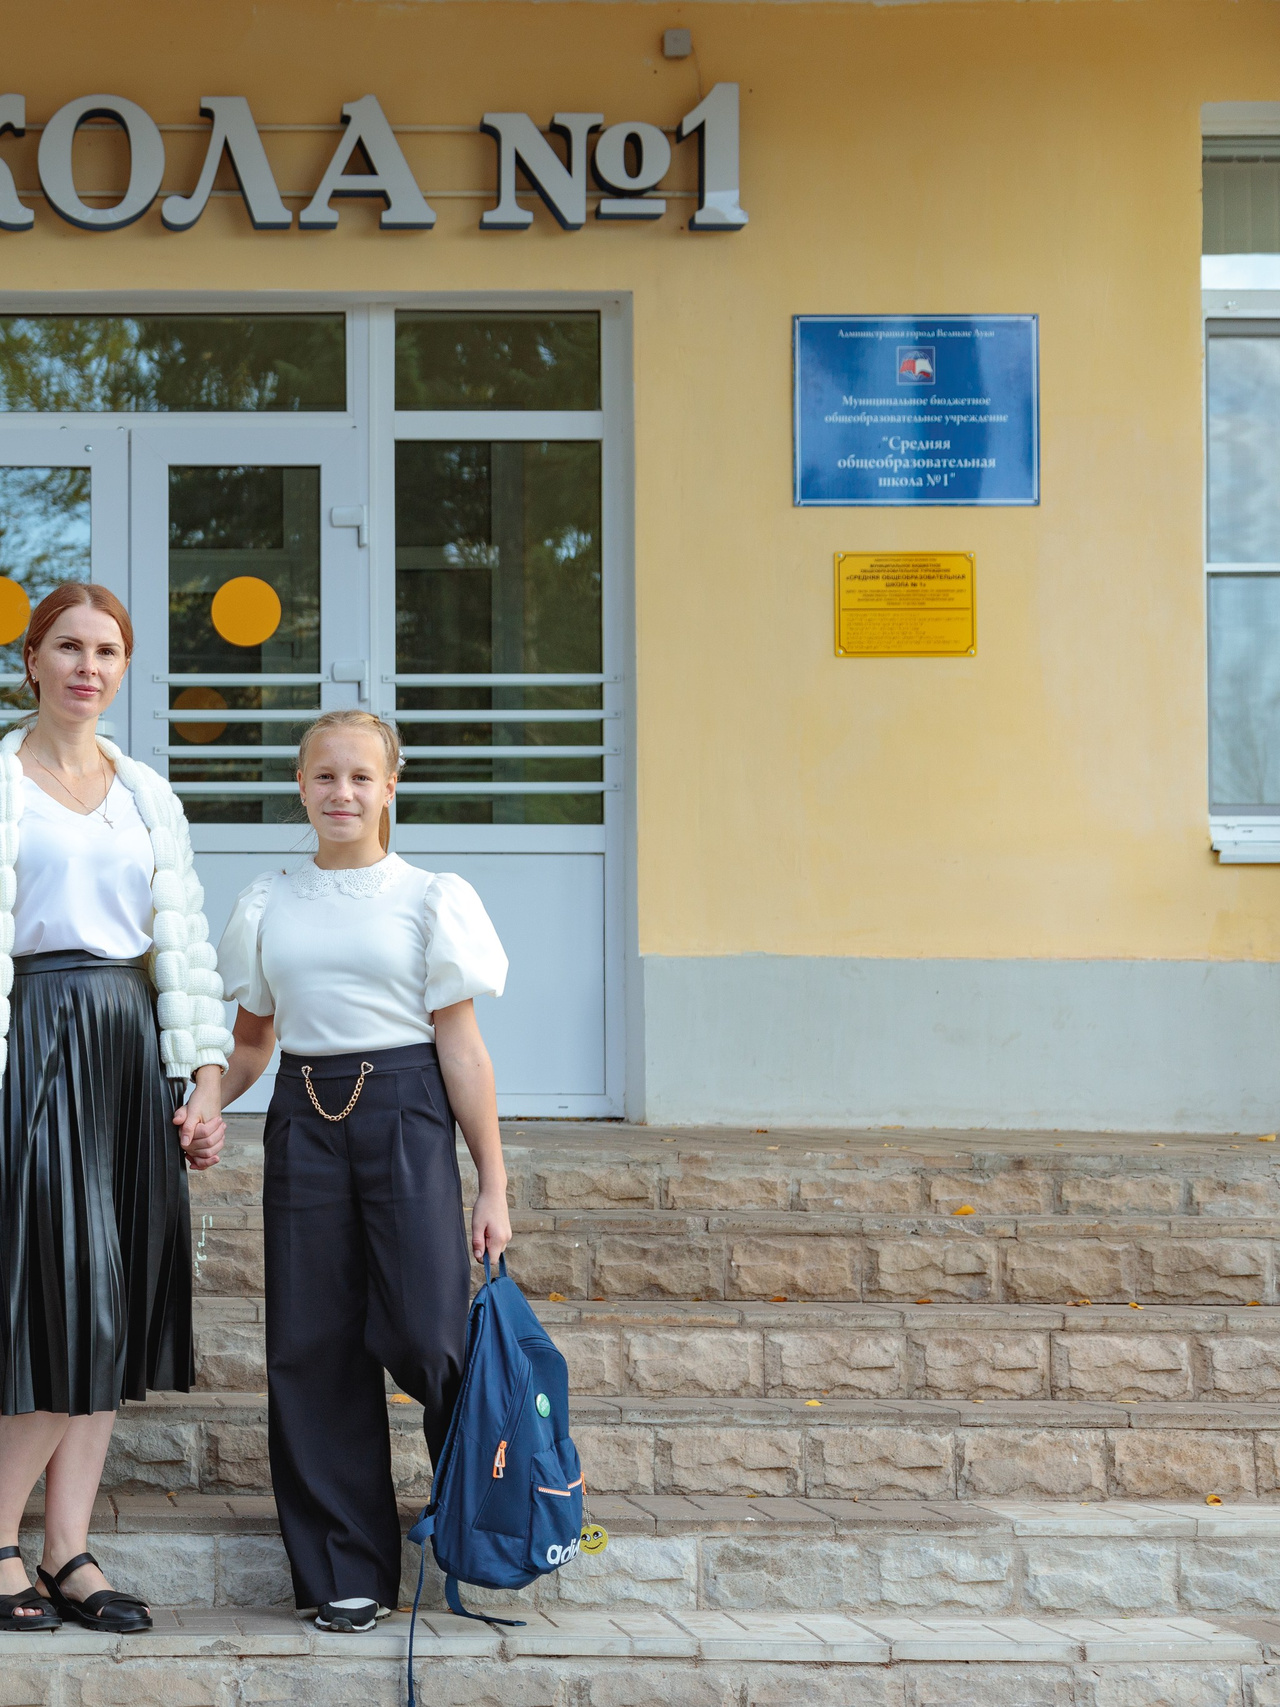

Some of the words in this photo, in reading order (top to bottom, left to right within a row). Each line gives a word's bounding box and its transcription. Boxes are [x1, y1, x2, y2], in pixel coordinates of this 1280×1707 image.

[837, 328, 905, 341] Администрация
[842, 394, 928, 409] Муниципальное
[930, 394, 991, 406] бюджетное
[824, 412, 943, 426] общеобразовательное
[945, 414, 1009, 426] учреждение
[882, 435, 951, 454] "Средняя
[837, 453, 996, 473] общеобразовательная
[878, 475, 923, 487] школа
